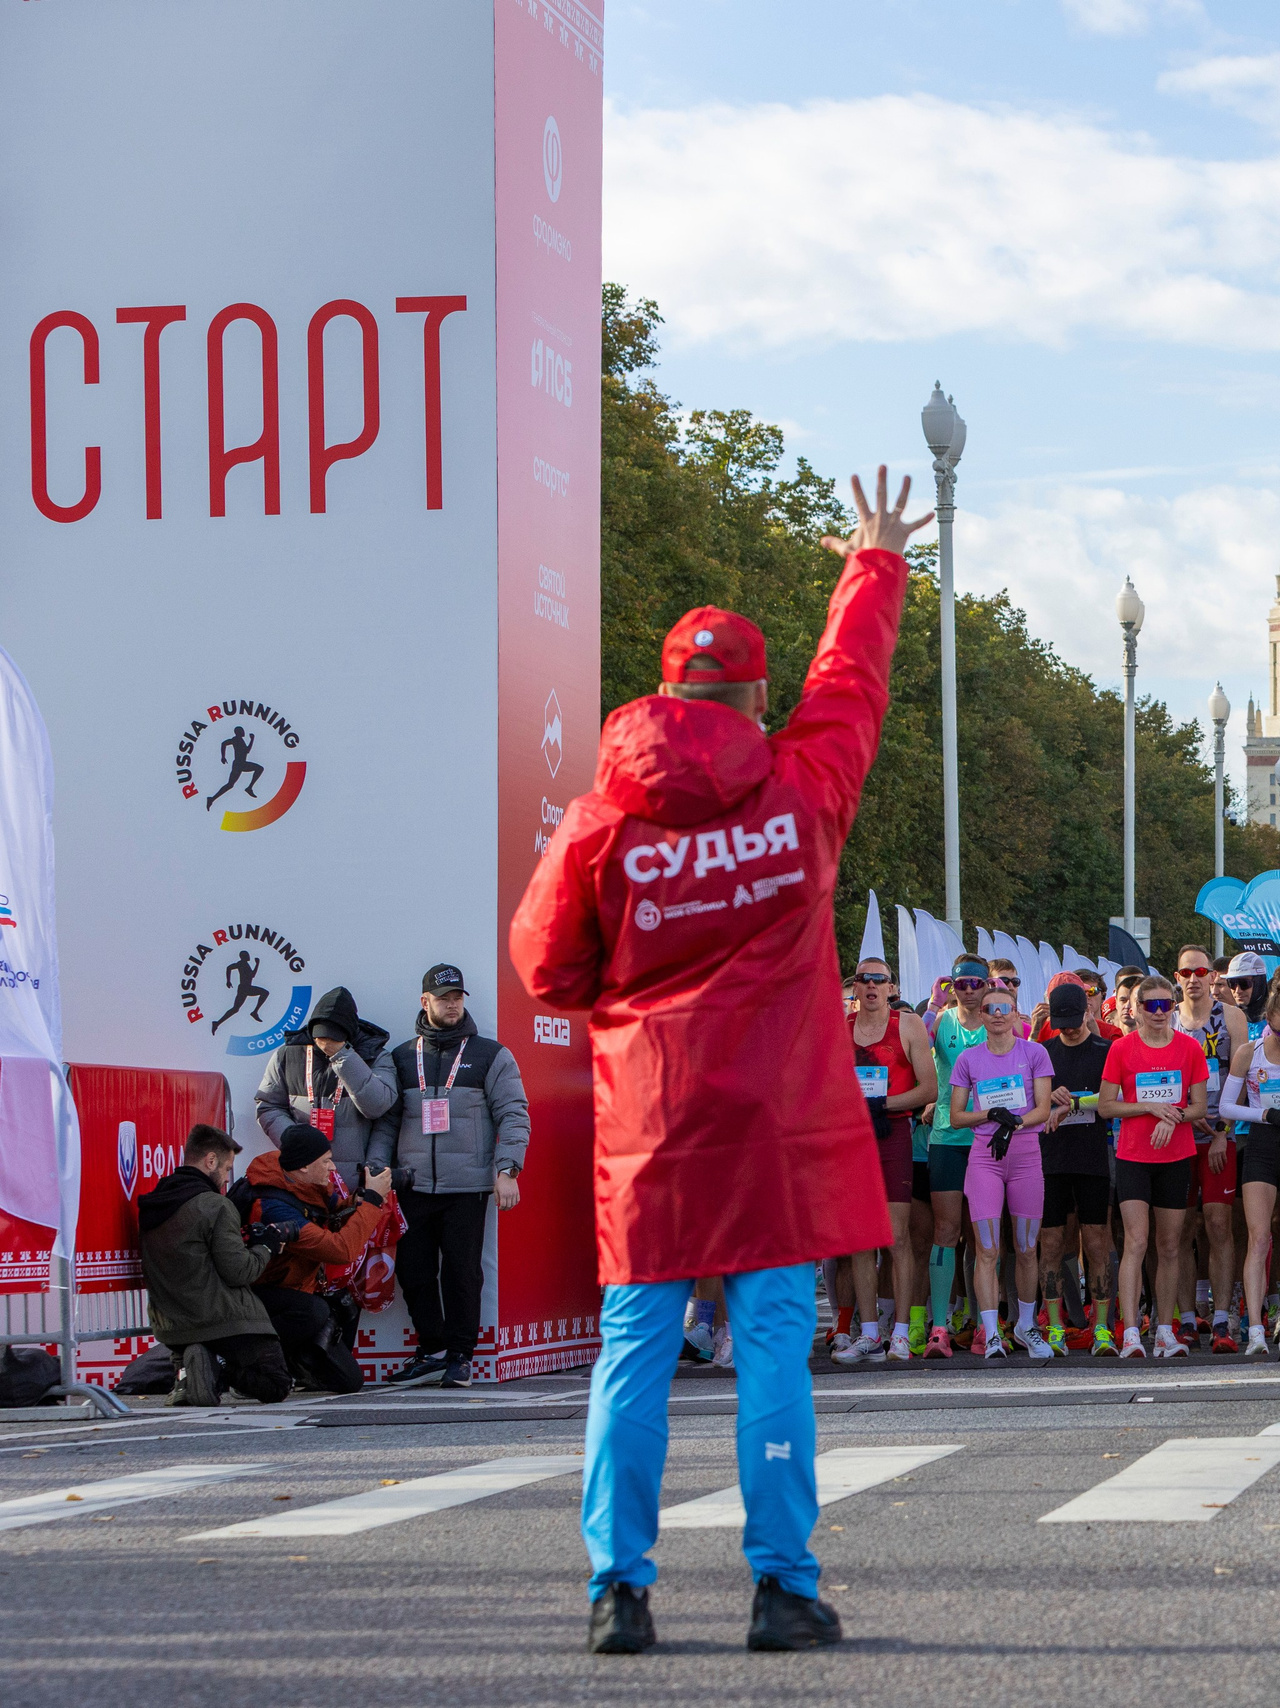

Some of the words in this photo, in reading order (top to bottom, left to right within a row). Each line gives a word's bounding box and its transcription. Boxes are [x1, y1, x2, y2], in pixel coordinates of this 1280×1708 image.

[29, 295, 467, 523] СТАРТ
[545, 345, 572, 408] ПСБ
[176, 720, 208, 800] RUSSIA
[207, 699, 300, 749] RUNNING
[623, 812, 800, 884] СУДЬЯ
[181, 943, 213, 1024] RUSSIA
[212, 923, 305, 973] RUNNING
[247, 1006, 303, 1050] СОБЫТИЯ
[1141, 1088, 1174, 1099] 23923
